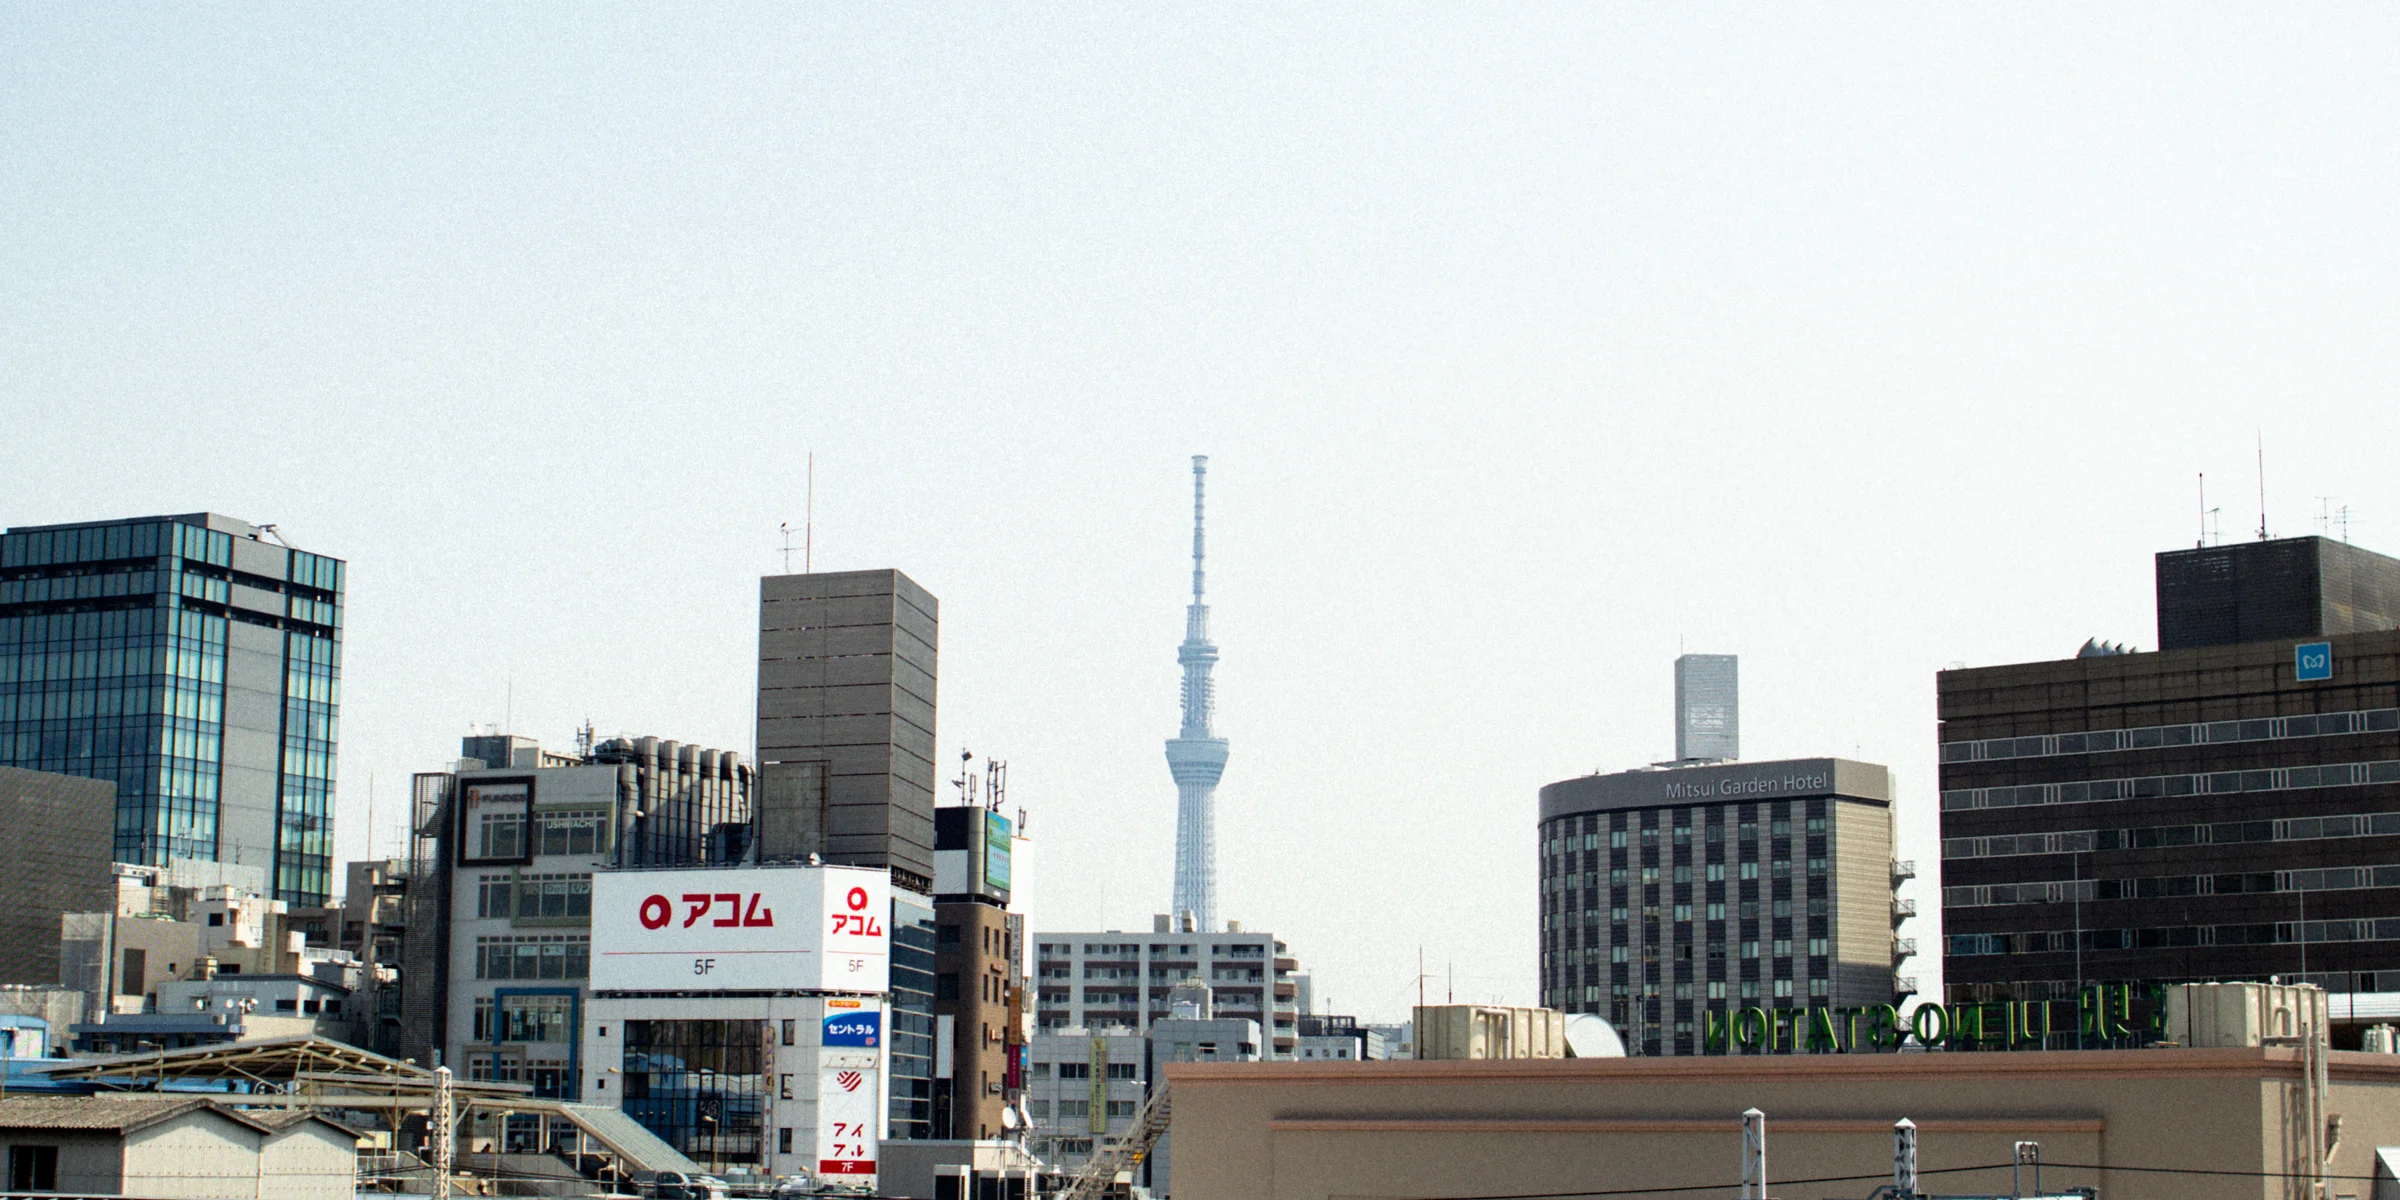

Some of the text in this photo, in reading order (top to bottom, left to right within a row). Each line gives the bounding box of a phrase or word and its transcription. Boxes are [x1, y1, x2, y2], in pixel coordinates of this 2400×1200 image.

[1666, 772, 1828, 798] Mitsui Garden Hotel
[682, 893, 774, 928] アコム
[832, 914, 883, 937] アコム
[694, 959, 716, 975] 5F
[848, 960, 865, 972] 5F
[828, 1023, 875, 1035] セントラル
[841, 1162, 854, 1172] 7F
